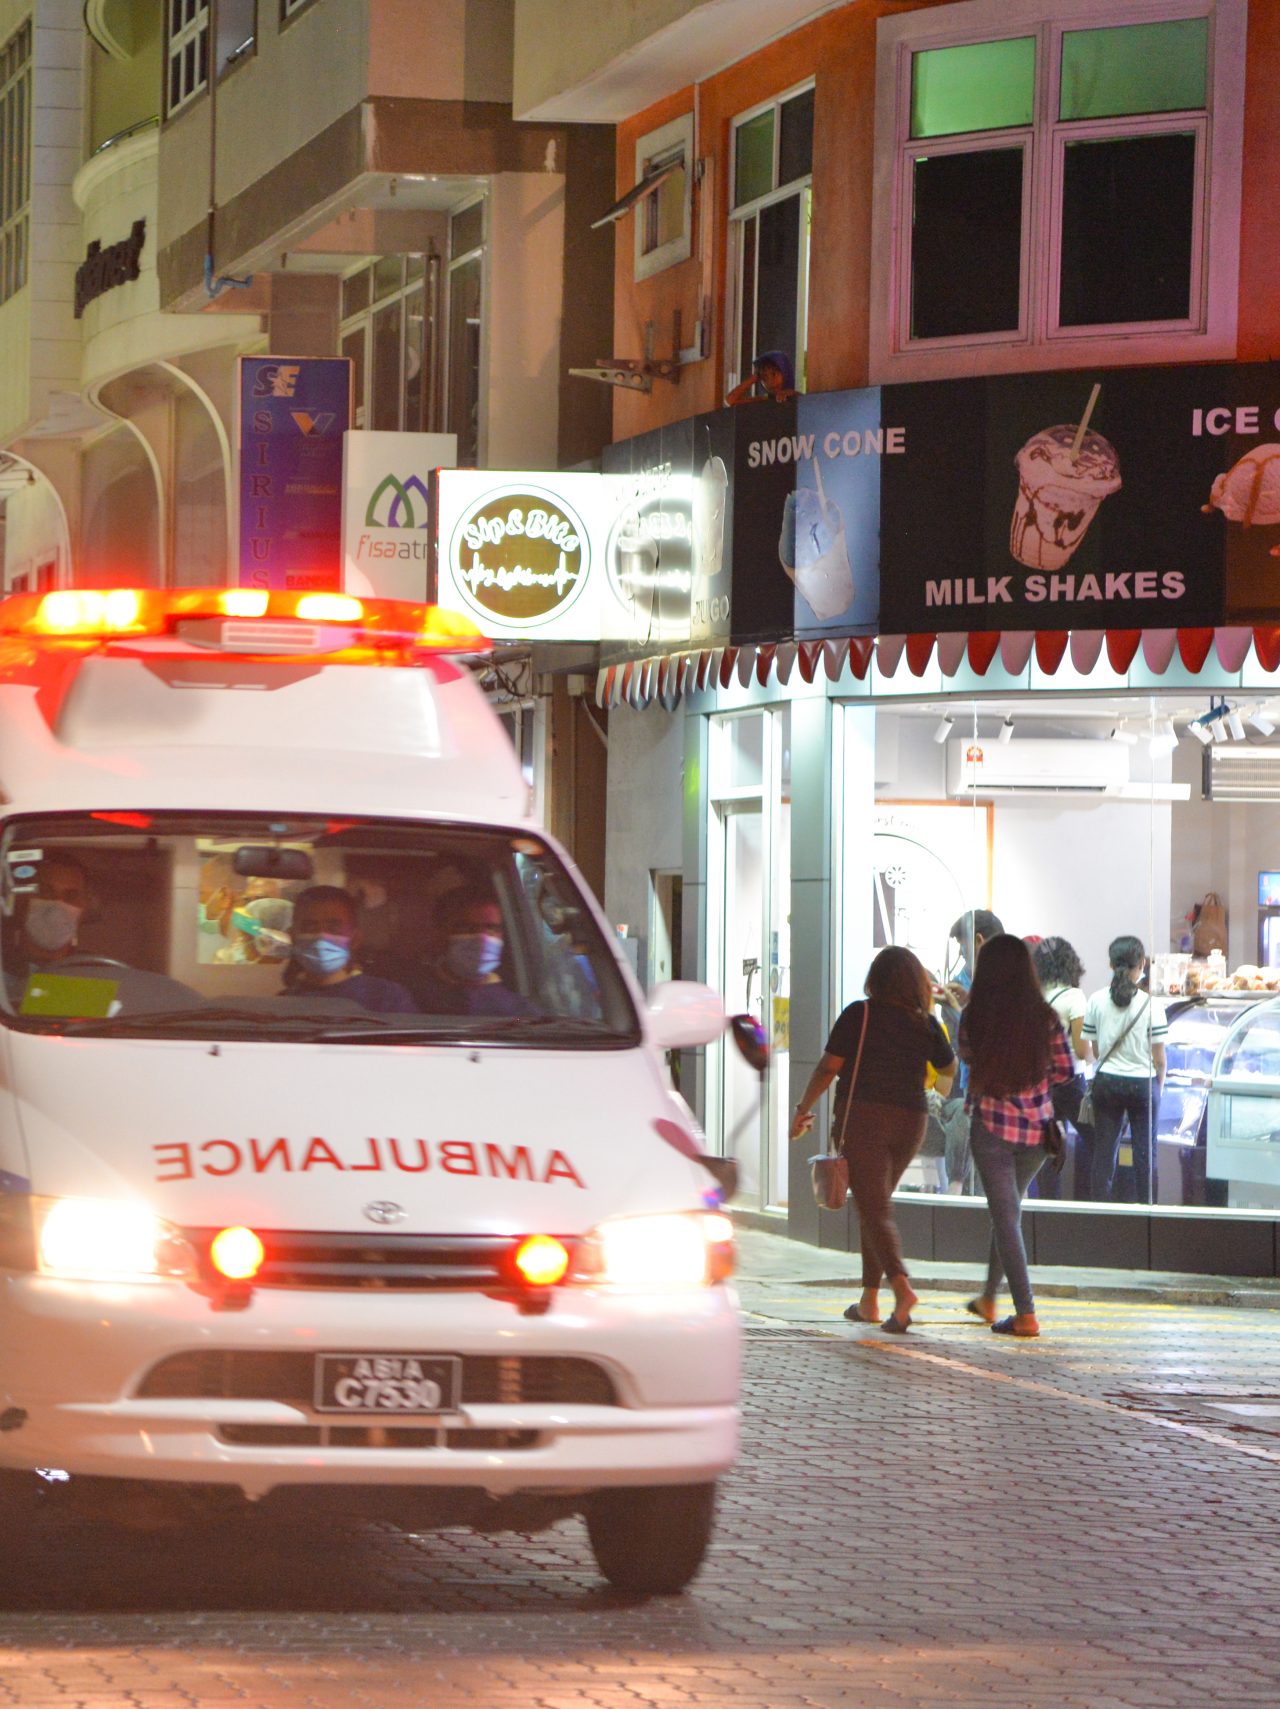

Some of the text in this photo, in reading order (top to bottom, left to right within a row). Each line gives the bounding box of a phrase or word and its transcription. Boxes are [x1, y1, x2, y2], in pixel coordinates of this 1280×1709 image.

[1192, 406, 1260, 436] ICE
[748, 427, 906, 468] SNOW CONE
[250, 411, 272, 591] SIRIUS
[925, 571, 1187, 607] MILK SHAKES
